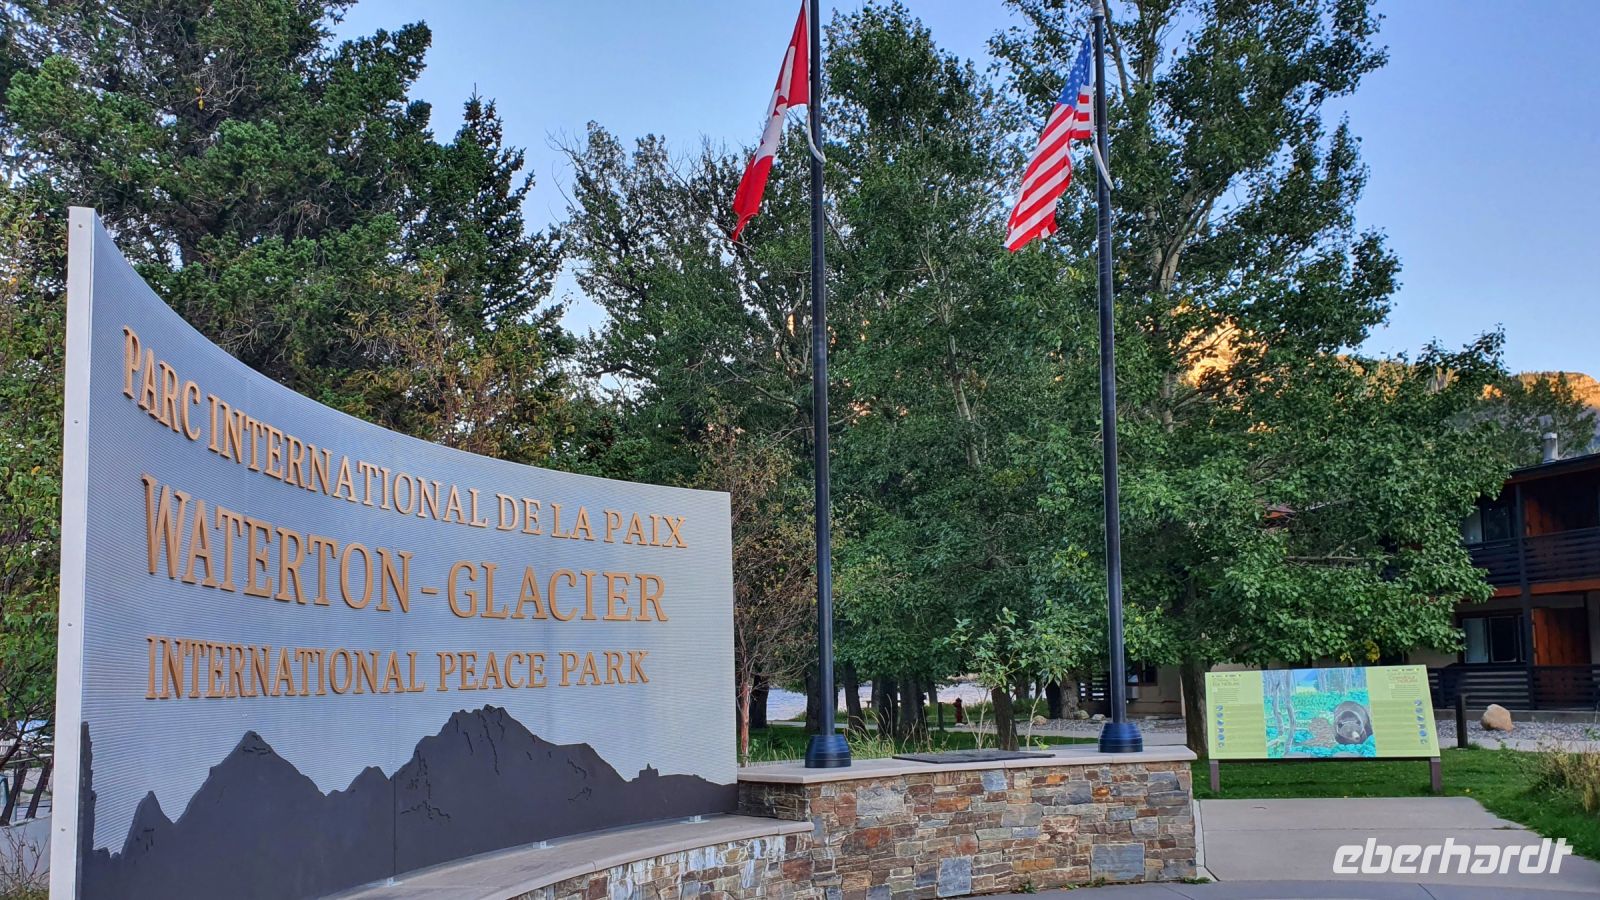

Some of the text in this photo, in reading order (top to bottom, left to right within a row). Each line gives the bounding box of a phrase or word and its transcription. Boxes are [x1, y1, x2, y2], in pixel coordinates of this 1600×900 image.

[122, 325, 688, 549] PARC INTERNATIONAL DE LA PAIX
[145, 634, 650, 700] INTERNATIONAL PEACE PARK
